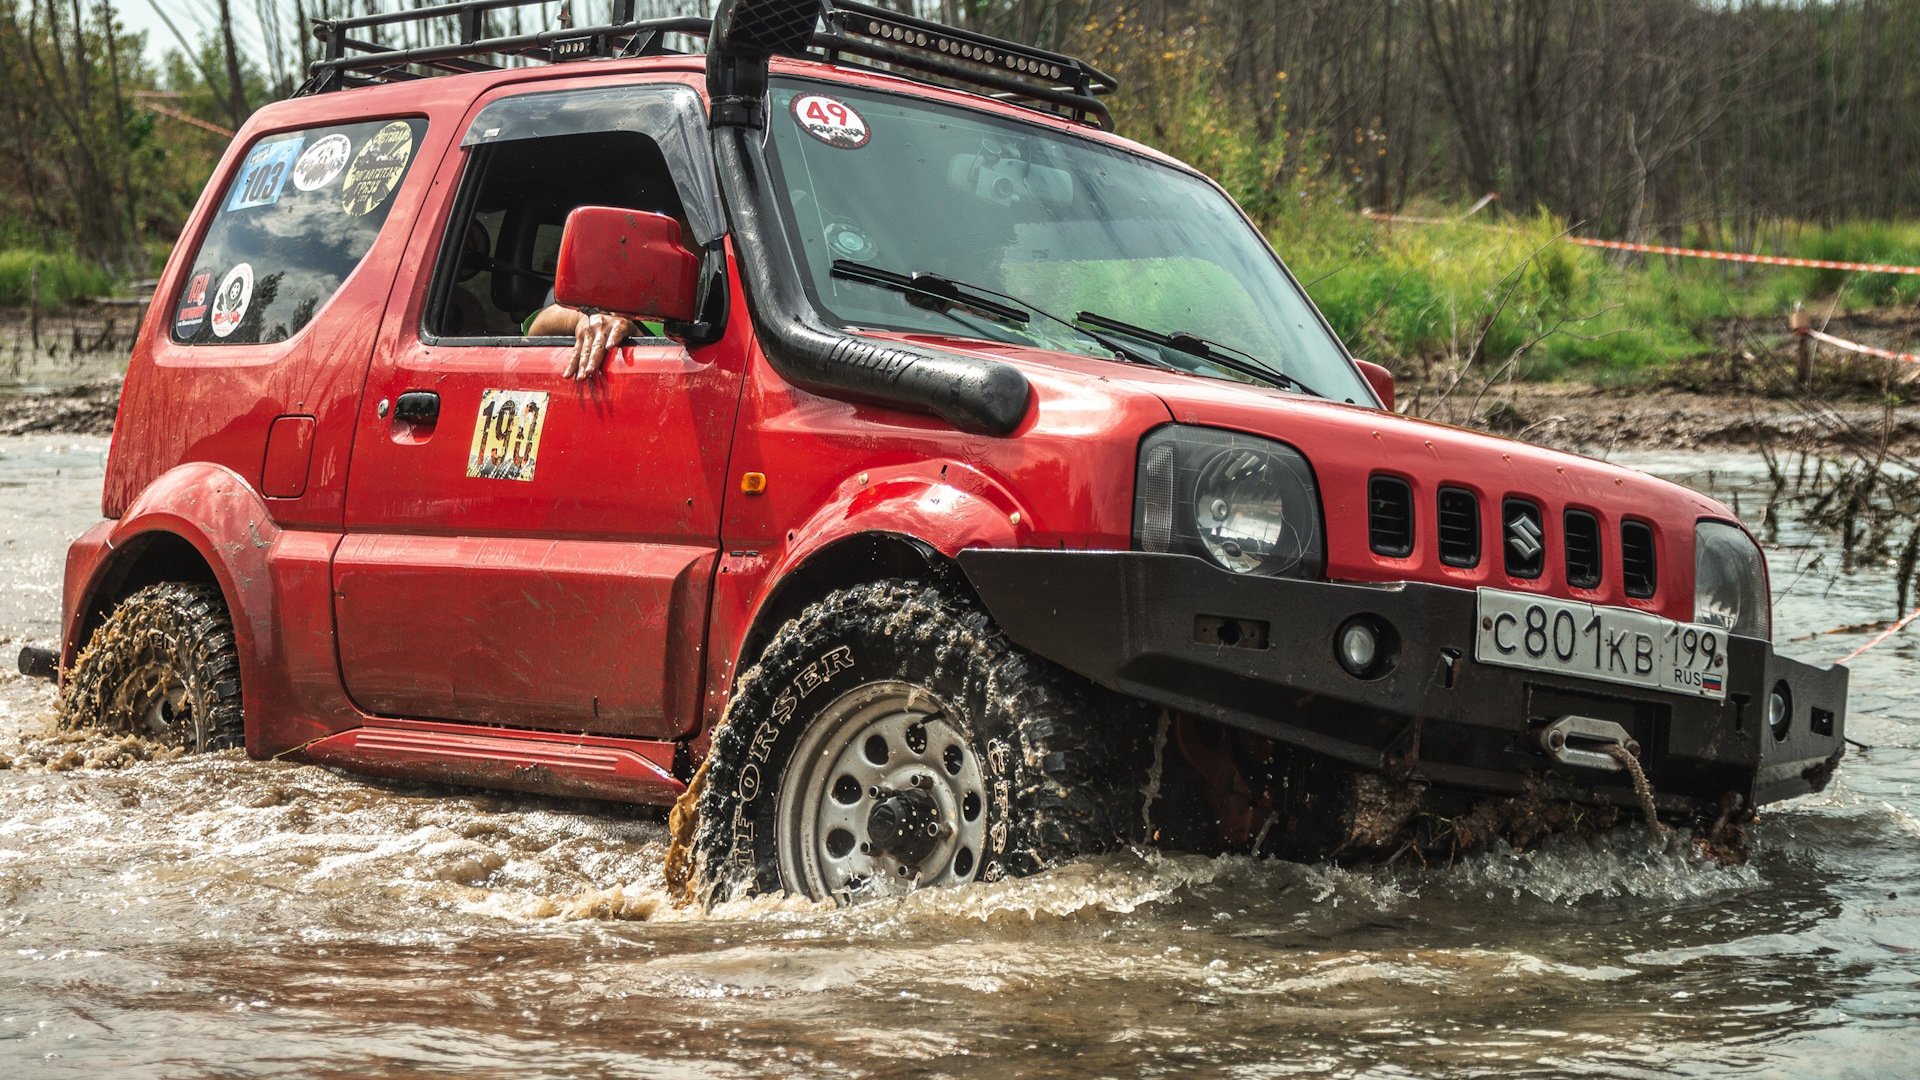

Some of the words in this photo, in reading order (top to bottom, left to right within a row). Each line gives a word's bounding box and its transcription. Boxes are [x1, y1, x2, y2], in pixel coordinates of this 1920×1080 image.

[806, 101, 847, 126] 49
[241, 162, 285, 204] 103
[478, 400, 540, 468] 190
[1663, 622, 1718, 672] 199
[1674, 668, 1702, 687] RUS
